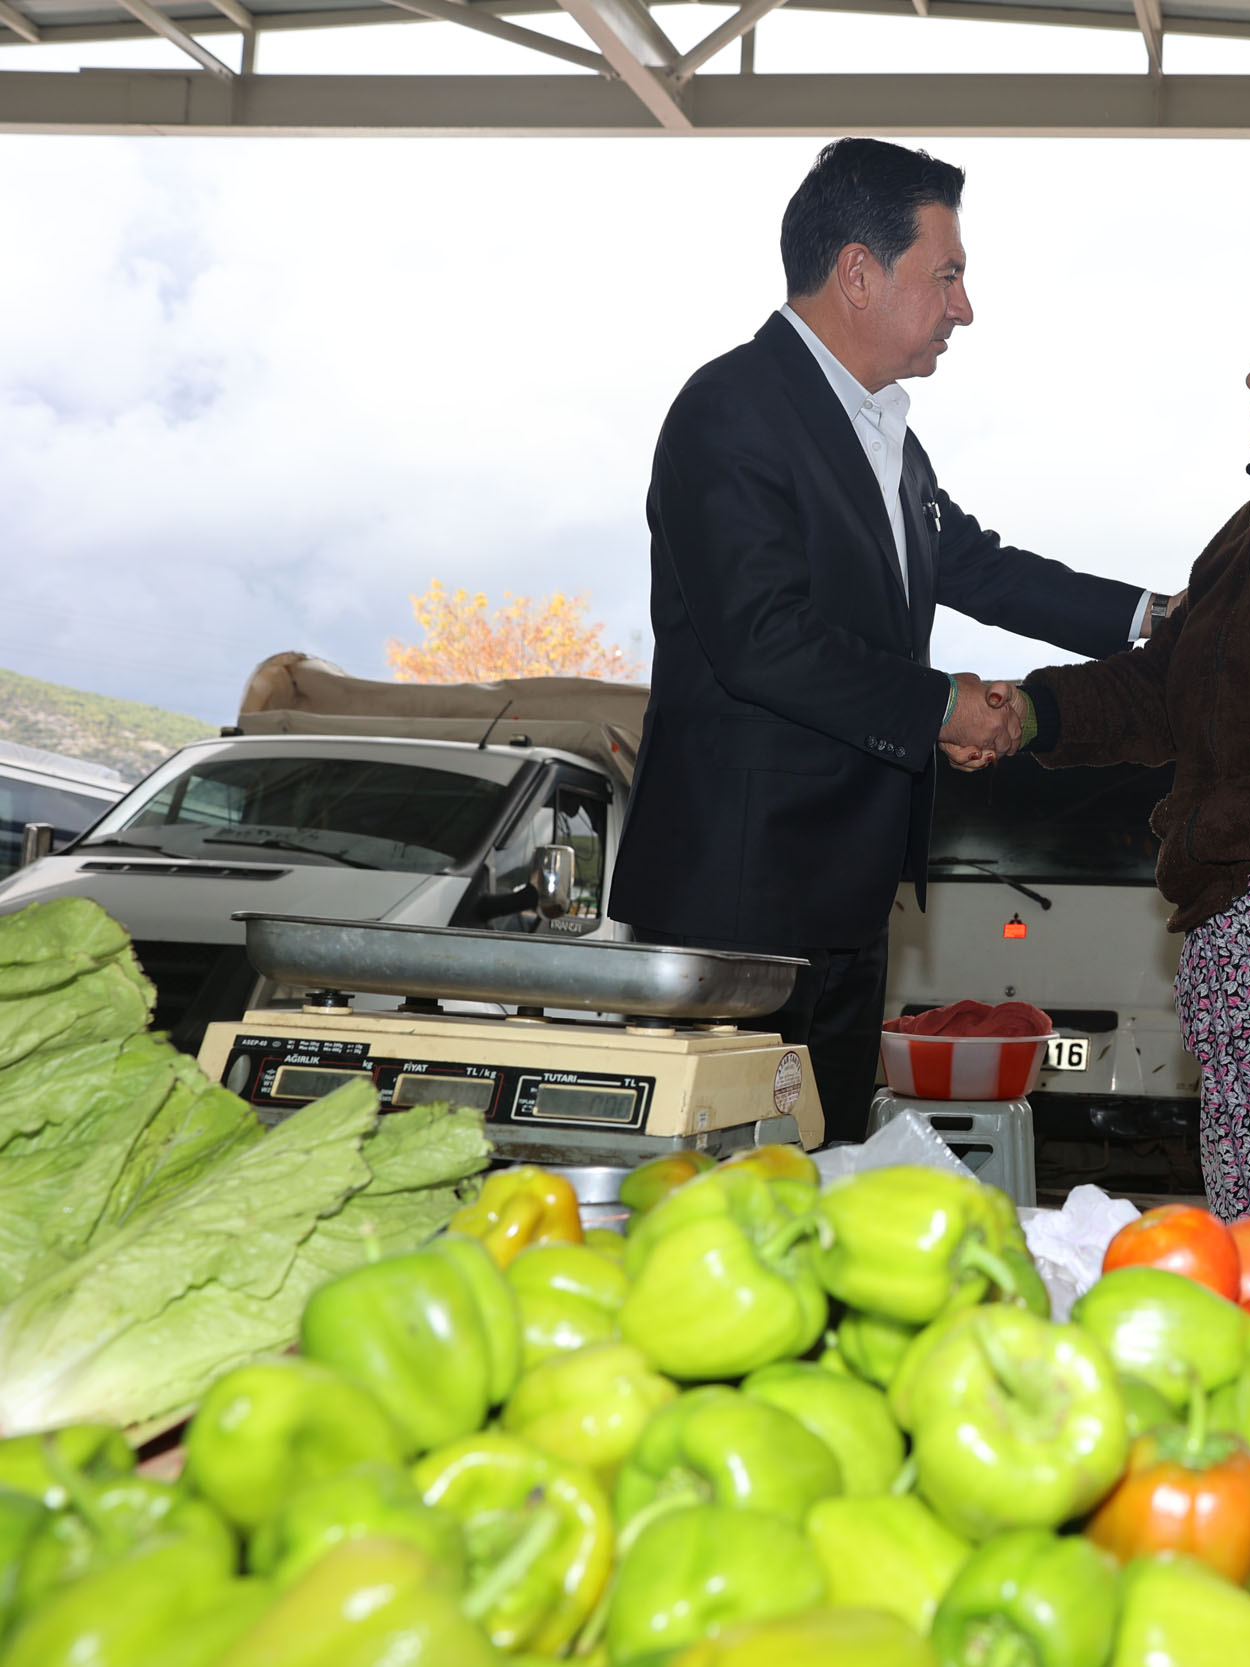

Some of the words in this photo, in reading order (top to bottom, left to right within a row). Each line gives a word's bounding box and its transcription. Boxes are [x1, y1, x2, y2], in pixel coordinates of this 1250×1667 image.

[284, 1053, 320, 1064] AĞIRLIK
[362, 1060, 374, 1070] kg
[403, 1062, 428, 1073] FİYAT
[544, 1073, 577, 1083] TUTARI
[624, 1079, 637, 1087] TL
